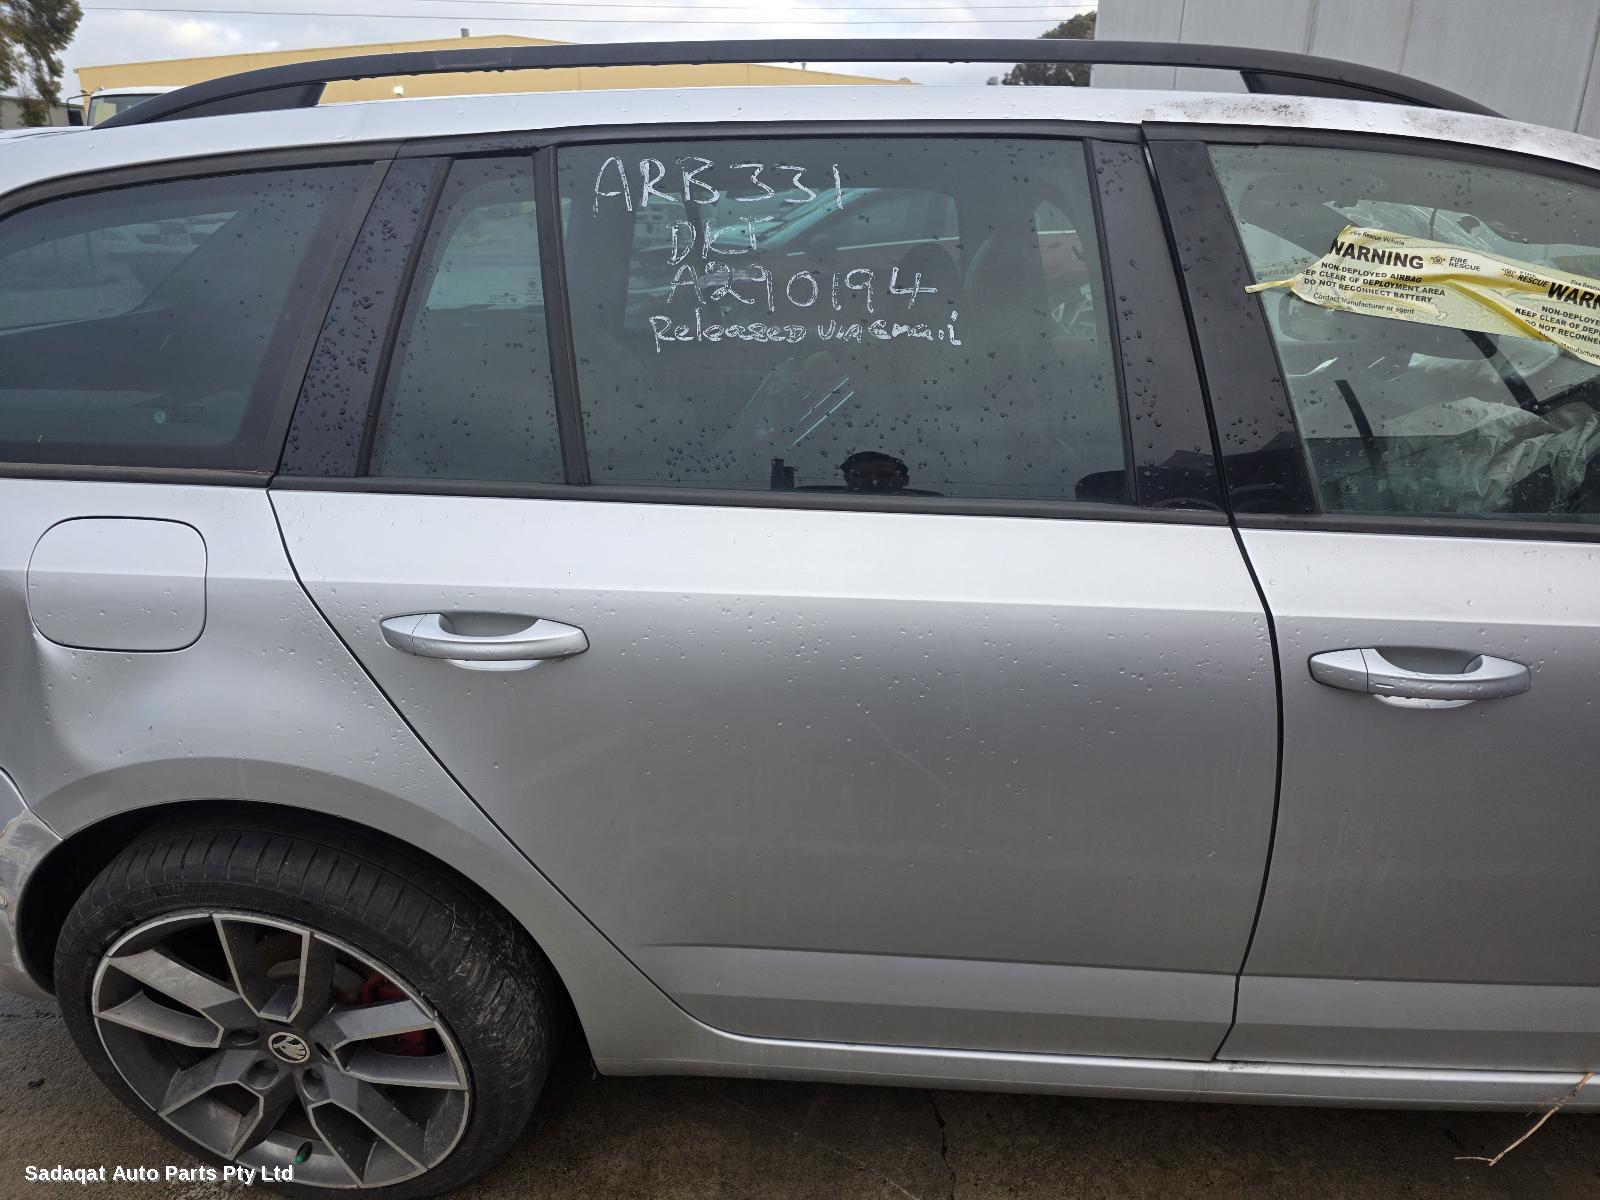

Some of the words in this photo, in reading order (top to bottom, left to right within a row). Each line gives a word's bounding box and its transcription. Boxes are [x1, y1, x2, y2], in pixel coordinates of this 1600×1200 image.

[1362, 232, 1382, 241] Rescue
[1449, 256, 1469, 265] FIRE
[1321, 262, 1387, 278] NON-DEPLOYED
[1390, 272, 1423, 284] AIRBAG
[1448, 262, 1481, 272] RESCUE
[1319, 270, 1346, 282] CLEAR
[1349, 275, 1360, 284] OF
[1362, 278, 1419, 292] DEPLOYMENT
[1422, 287, 1446, 297] AREA
[1517, 274, 1549, 288] RESCUE
[1304, 277, 1316, 285] DO
[1319, 279, 1336, 287] NOT
[1338, 283, 1391, 297] RECONNECT
[1393, 292, 1432, 304] BATTERY
[1313, 292, 1340, 303] Contact
[1514, 307, 1538, 318] KEEP
[1540, 314, 1567, 326] CLEAR
[1568, 322, 1580, 330] OF
[1538, 323, 1557, 333] NOT
